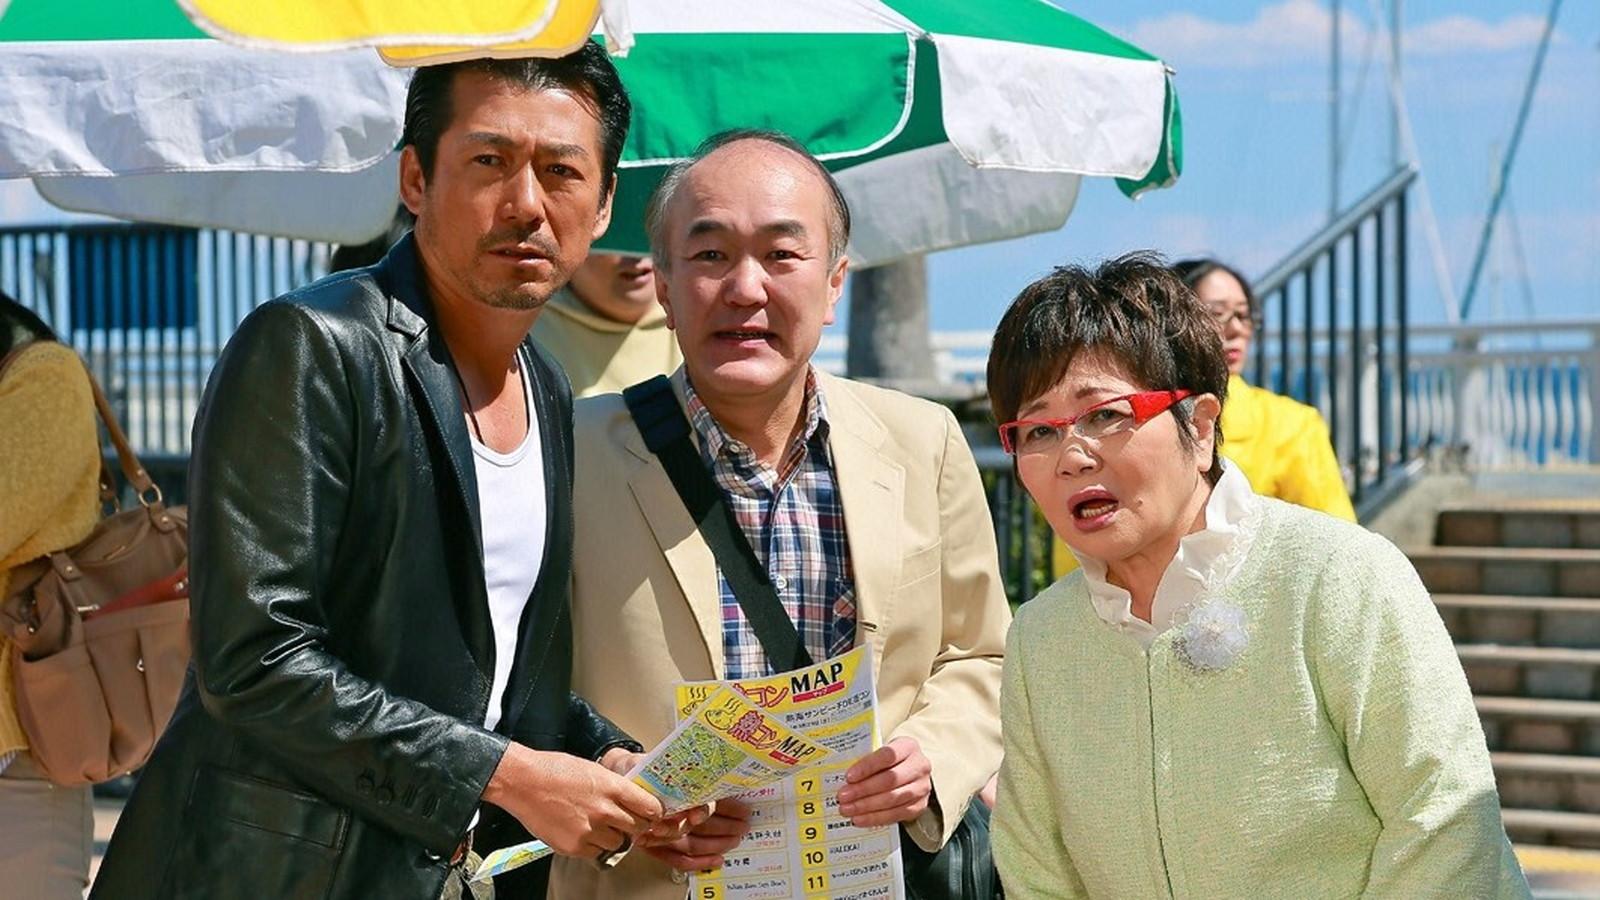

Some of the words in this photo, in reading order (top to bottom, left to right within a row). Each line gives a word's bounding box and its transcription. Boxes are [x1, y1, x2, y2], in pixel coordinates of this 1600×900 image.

[732, 683, 789, 707] コン
[791, 662, 843, 694] MAP
[776, 735, 816, 759] MAP
[801, 780, 813, 792] 7
[803, 802, 815, 814] 8
[805, 827, 817, 839] 9
[805, 851, 824, 864] 10
[808, 876, 824, 889] 11
[703, 887, 715, 899] 5
